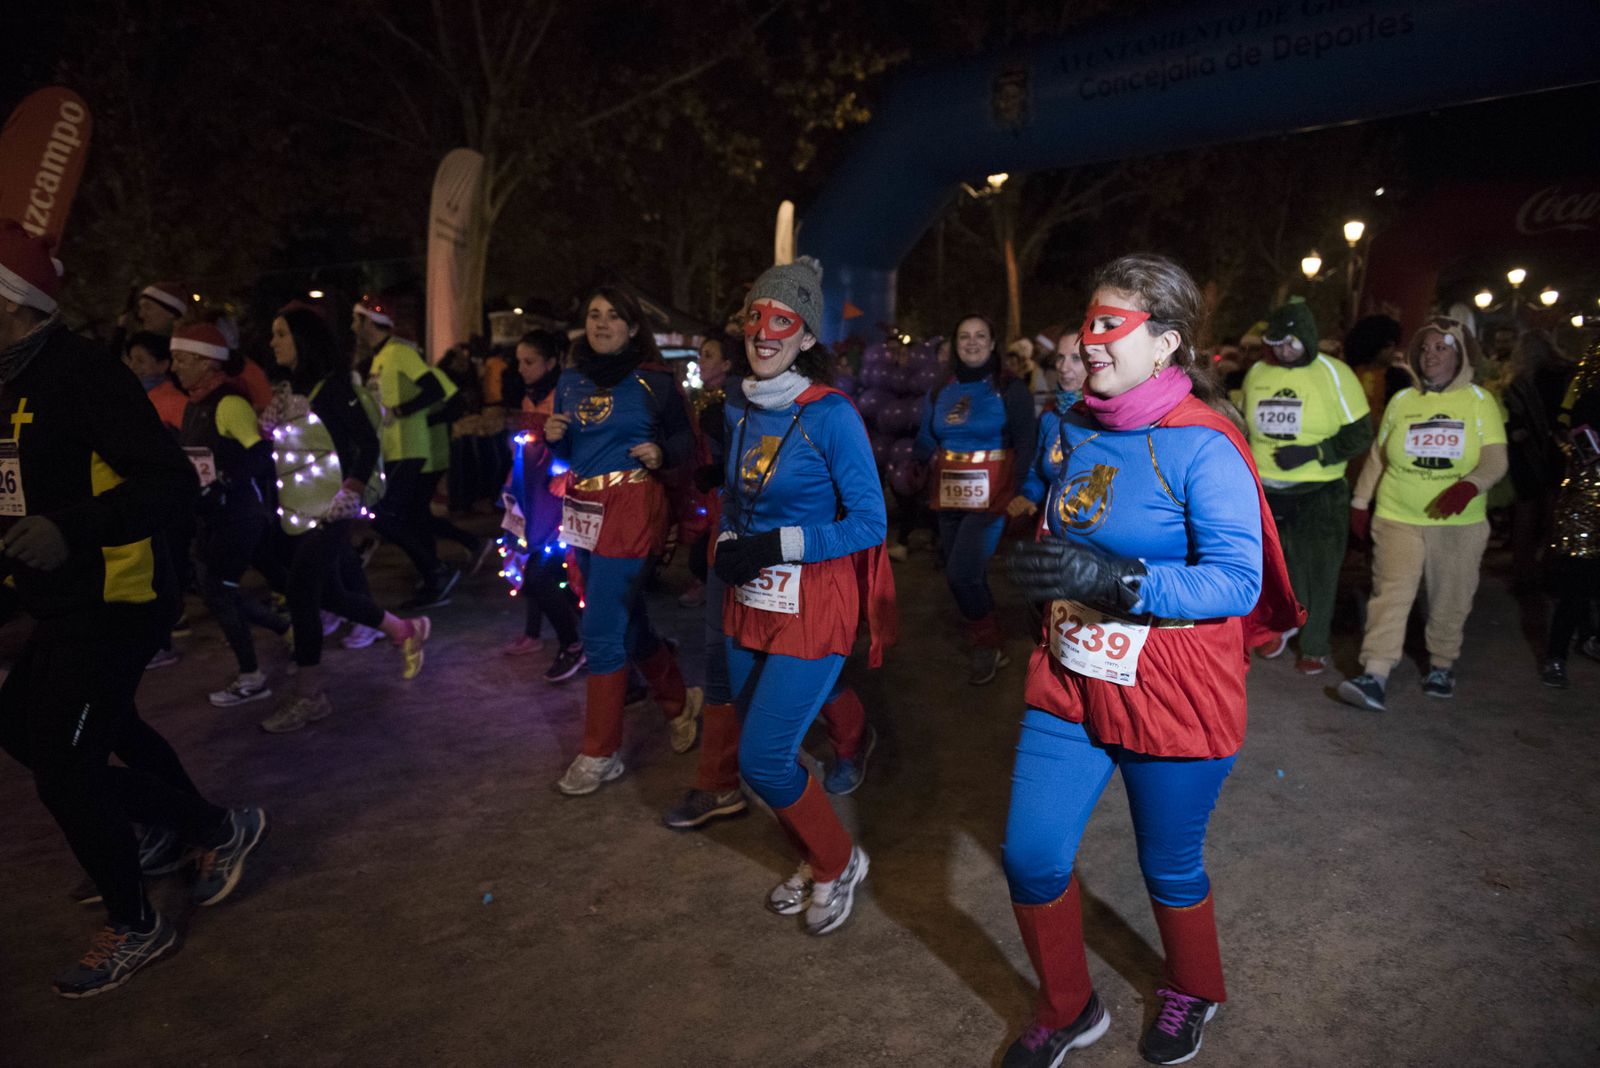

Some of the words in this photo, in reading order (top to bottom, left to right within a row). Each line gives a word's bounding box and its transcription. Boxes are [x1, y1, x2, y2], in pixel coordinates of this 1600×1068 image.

[1225, 44, 1261, 73] de
[1272, 12, 1415, 61] Deportes
[1259, 411, 1296, 423] 1206
[1412, 434, 1459, 447] 1209
[944, 485, 984, 498] 1955
[1054, 606, 1131, 660] 2239
